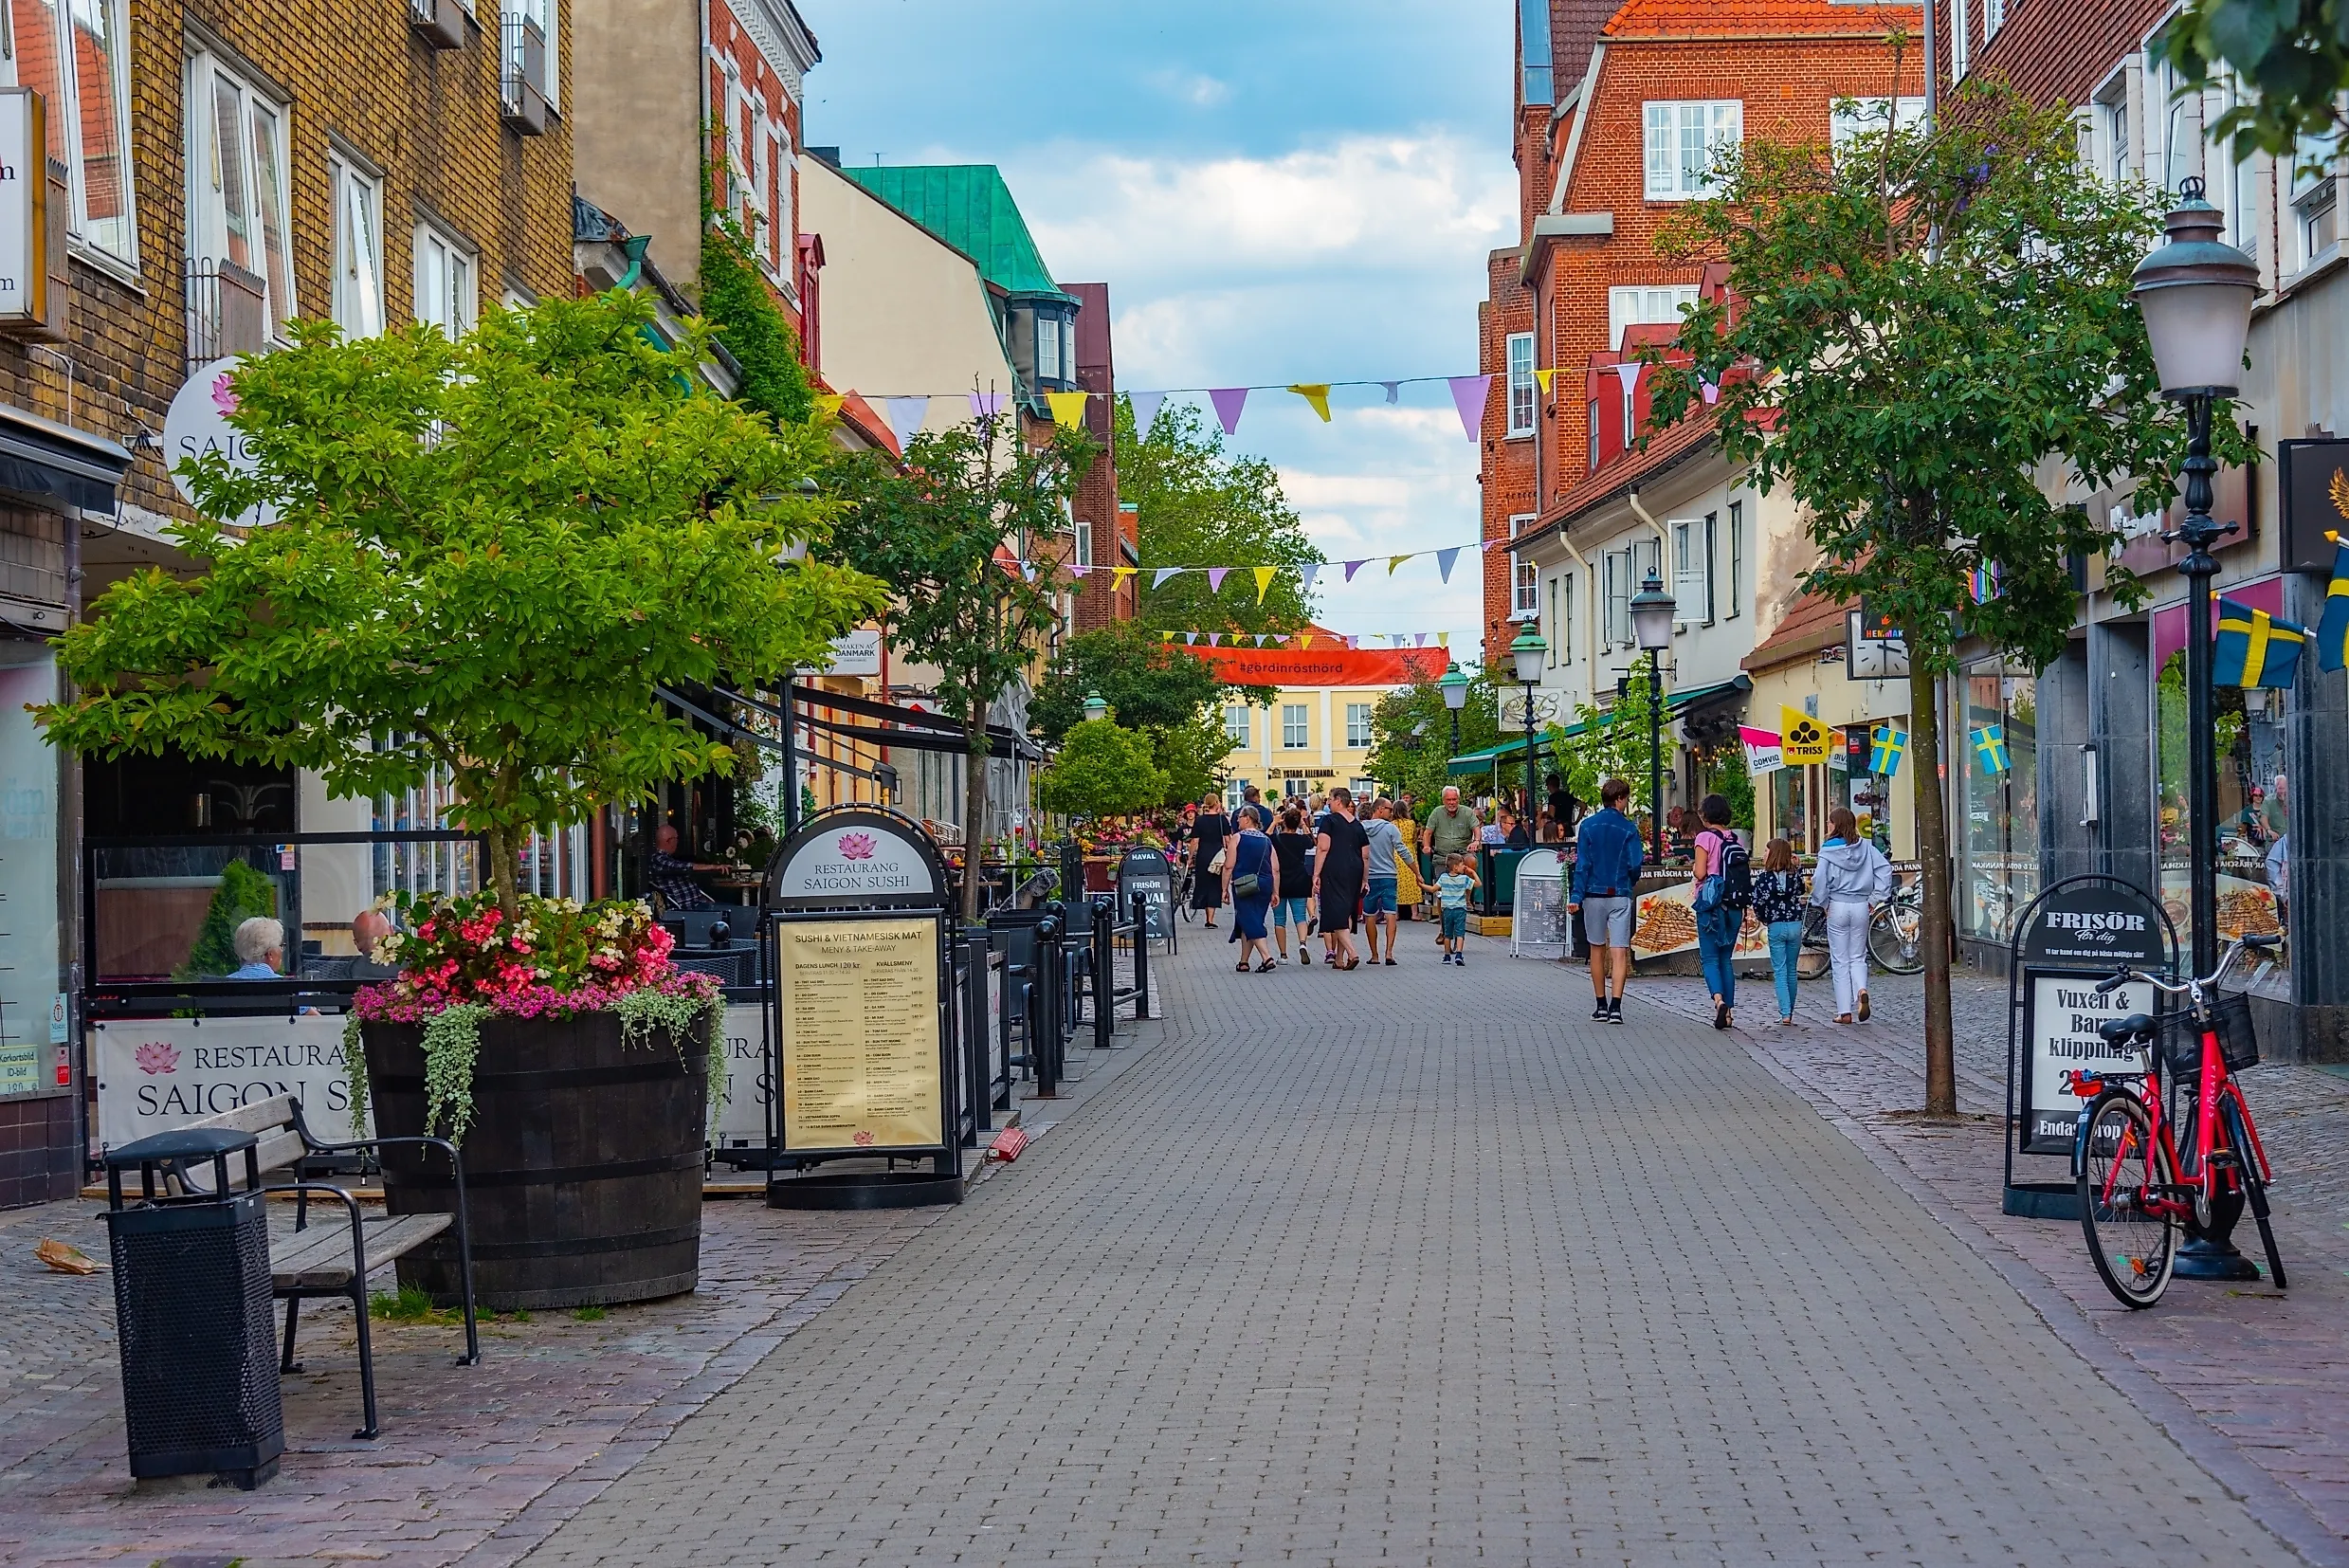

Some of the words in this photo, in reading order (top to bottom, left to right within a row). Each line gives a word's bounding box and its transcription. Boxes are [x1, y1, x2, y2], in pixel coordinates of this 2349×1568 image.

[1239, 663, 1343, 674] #gördinrösthörd
[1796, 746, 1823, 756] TRISS
[1754, 754, 1780, 766] COMVIQ
[1284, 769, 1302, 778] YSTADS
[814, 863, 899, 875] RESTAURANG
[1653, 869, 1682, 878] FRÄSCHA
[804, 877, 862, 890] SAIGON
[867, 875, 910, 888] SUSHI
[1132, 880, 1161, 889] FRISÖR
[2046, 911, 2145, 931] FRISÖR
[795, 935, 823, 943] SUSHI
[825, 934, 830, 942] &
[832, 932, 901, 942] VIETNAMESISK
[901, 931, 922, 939] MAT
[2074, 929, 2098, 941] För
[2096, 931, 2117, 944] dig
[2056, 989, 2109, 1010] Vuxen
[2115, 991, 2130, 1011] &
[193, 1045, 347, 1069] RESTAURA
[8, 1067, 27, 1077] ID-bild
[2206, 1065, 2217, 1118] SJÖSALA
[137, 1081, 306, 1116] SAIGON
